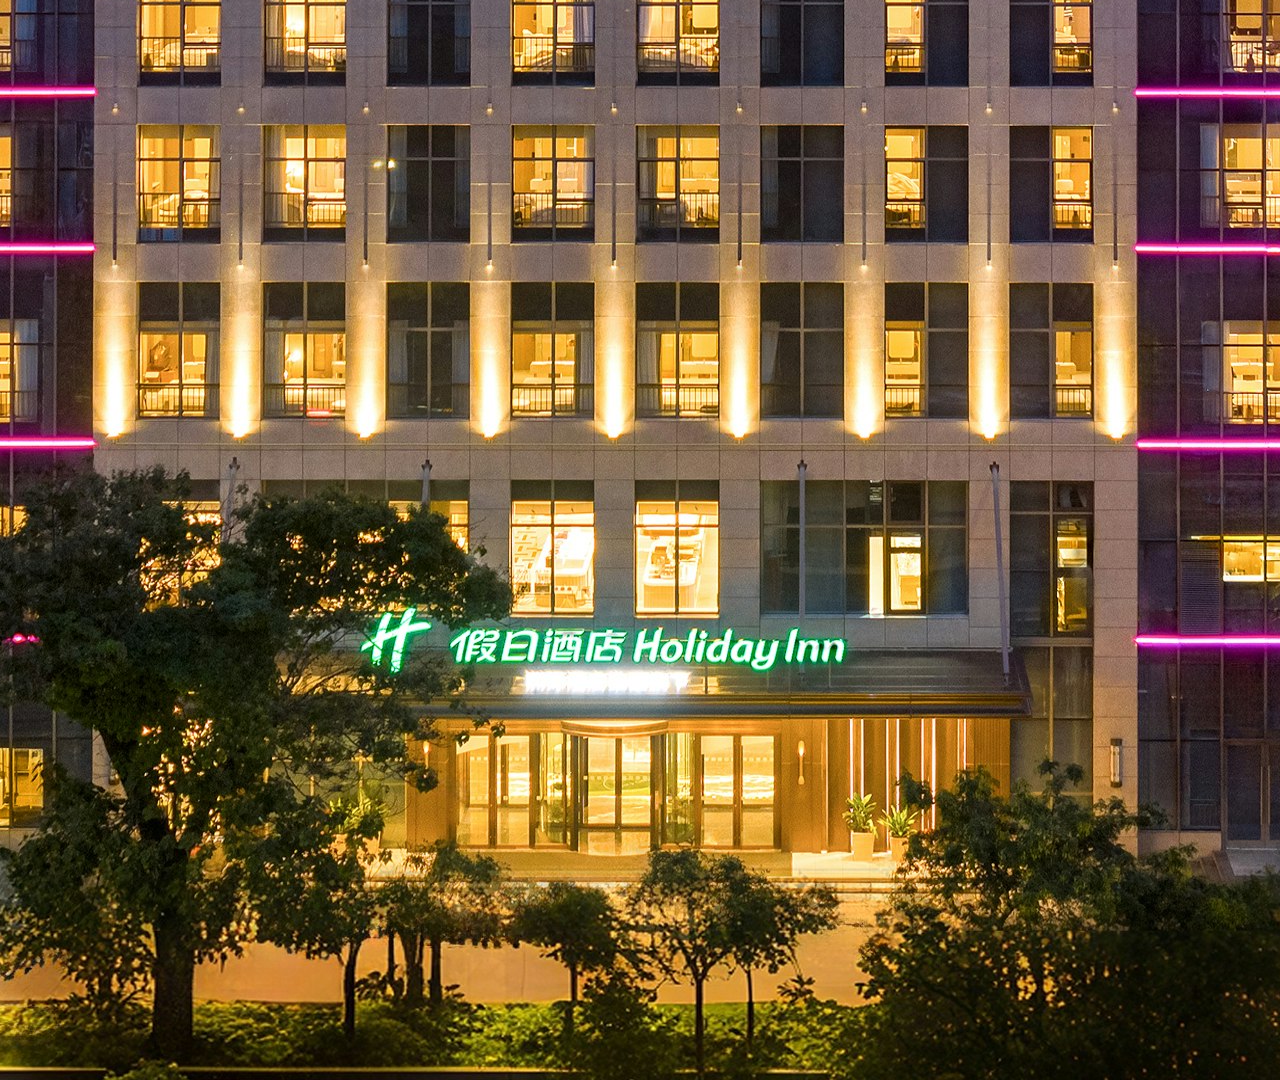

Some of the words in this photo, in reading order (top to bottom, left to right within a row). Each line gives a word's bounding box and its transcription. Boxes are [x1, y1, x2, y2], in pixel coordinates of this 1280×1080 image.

[449, 627, 628, 664] 假日酒店
[632, 627, 779, 671] Holiday
[783, 627, 847, 664] Inn
